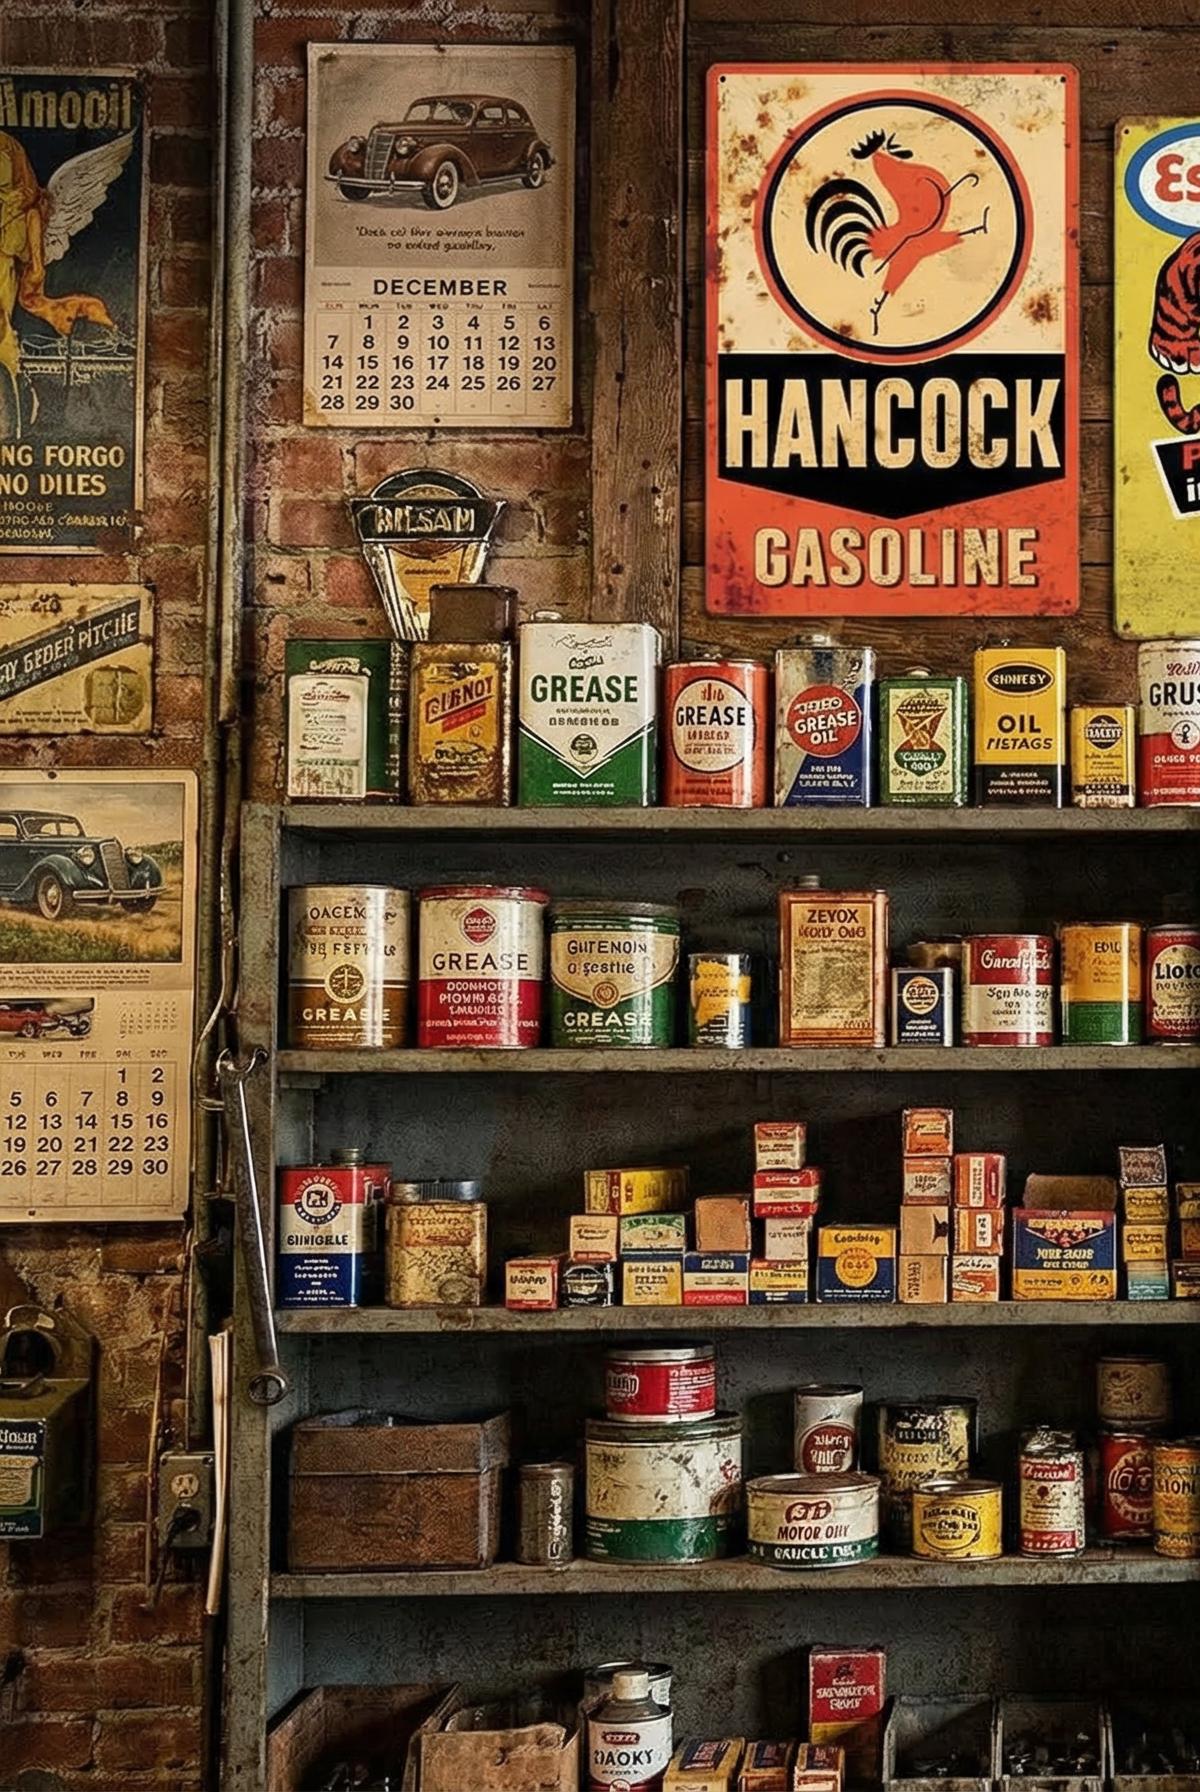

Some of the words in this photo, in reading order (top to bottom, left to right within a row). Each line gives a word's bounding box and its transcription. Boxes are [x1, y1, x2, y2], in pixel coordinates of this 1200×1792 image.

[374, 279, 508, 295] DECEMBER
[364, 316, 371, 329] 1
[398, 315, 408, 329] 2
[432, 316, 443, 329] 3
[467, 316, 479, 329] 4
[503, 316, 514, 329] 5
[538, 316, 550, 330] 6
[327, 335, 338, 348] 7
[362, 335, 374, 349] 8
[397, 335, 408, 349] 9
[427, 336, 449, 349] 10
[463, 337, 481, 349] 11
[498, 336, 519, 350] 12
[533, 337, 555, 350] 13
[322, 356, 343, 369] 14
[357, 356, 378, 369] 15
[392, 356, 413, 369] 16
[427, 356, 448, 369] 17
[463, 356, 484, 370] 18
[498, 356, 519, 370] 19
[532, 357, 556, 370] 20
[322, 375, 341, 388] 21
[356, 376, 379, 389] 22
[391, 376, 413, 389] 23
[426, 376, 449, 389] 24
[461, 376, 485, 390] 25
[496, 377, 520, 390] 26
[532, 377, 556, 390] 27
[321, 395, 344, 409] 28
[355, 396, 379, 409] 29
[390, 396, 413, 409] 30
[725, 378, 1060, 469] HANCOCK
[45, 445, 125, 468] FORGO
[40, 474, 107, 495] DILES
[754, 527, 1039, 587] GASOLINE
[531, 675, 638, 703] GREASE
[676, 705, 746, 727] GREASE
[795, 711, 857, 733] GREASE
[997, 715, 1041, 734] OIL
[810, 730, 839, 745] OIL
[433, 953, 529, 970] GREASE
[117, 1069, 125, 1083] 1
[151, 1068, 163, 1082] 2
[9, 1092, 21, 1106] 5
[45, 1092, 57, 1106] 6
[81, 1092, 93, 1106] 7
[116, 1091, 128, 1106] 8
[151, 1091, 163, 1106] 9
[5, 1115, 26, 1129] 12
[39, 1115, 62, 1129] 13
[75, 1115, 97, 1129] 14
[111, 1114, 132, 1128] 15
[145, 1114, 167, 1128] 16
[3, 1138, 25, 1152] 19
[37, 1137, 62, 1152] 20
[74, 1137, 96, 1152] 21
[108, 1137, 133, 1151] 22
[143, 1136, 168, 1151] 23
[1, 1160, 26, 1175] 26
[36, 1161, 61, 1175] 27
[72, 1160, 96, 1175] 28
[107, 1160, 132, 1175] 29
[142, 1160, 168, 1174] 30
